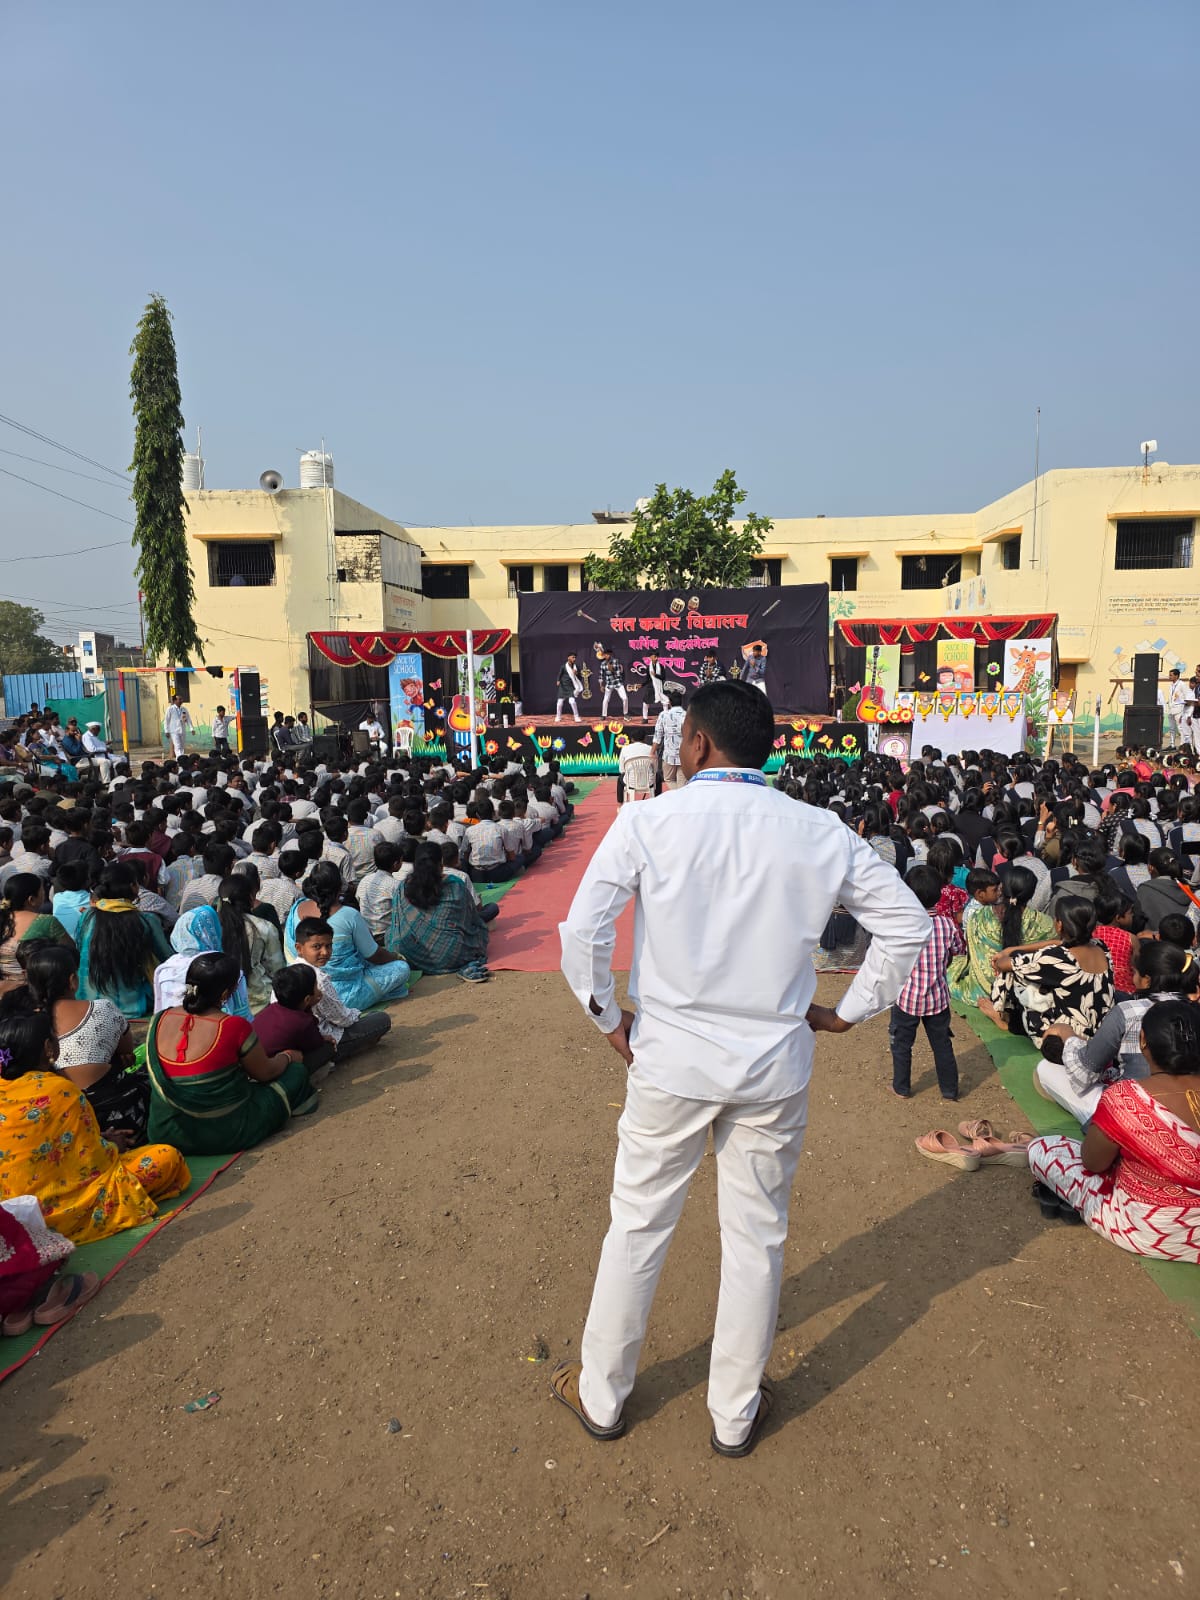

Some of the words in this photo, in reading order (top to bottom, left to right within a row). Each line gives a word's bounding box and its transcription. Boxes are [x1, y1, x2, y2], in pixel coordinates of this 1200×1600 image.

[610, 613, 636, 632] संत
[639, 612, 681, 632] कबीर
[686, 610, 749, 630] विद्यालय
[944, 651, 969, 661] SCHOOL
[393, 664, 417, 674] SCHOOL
